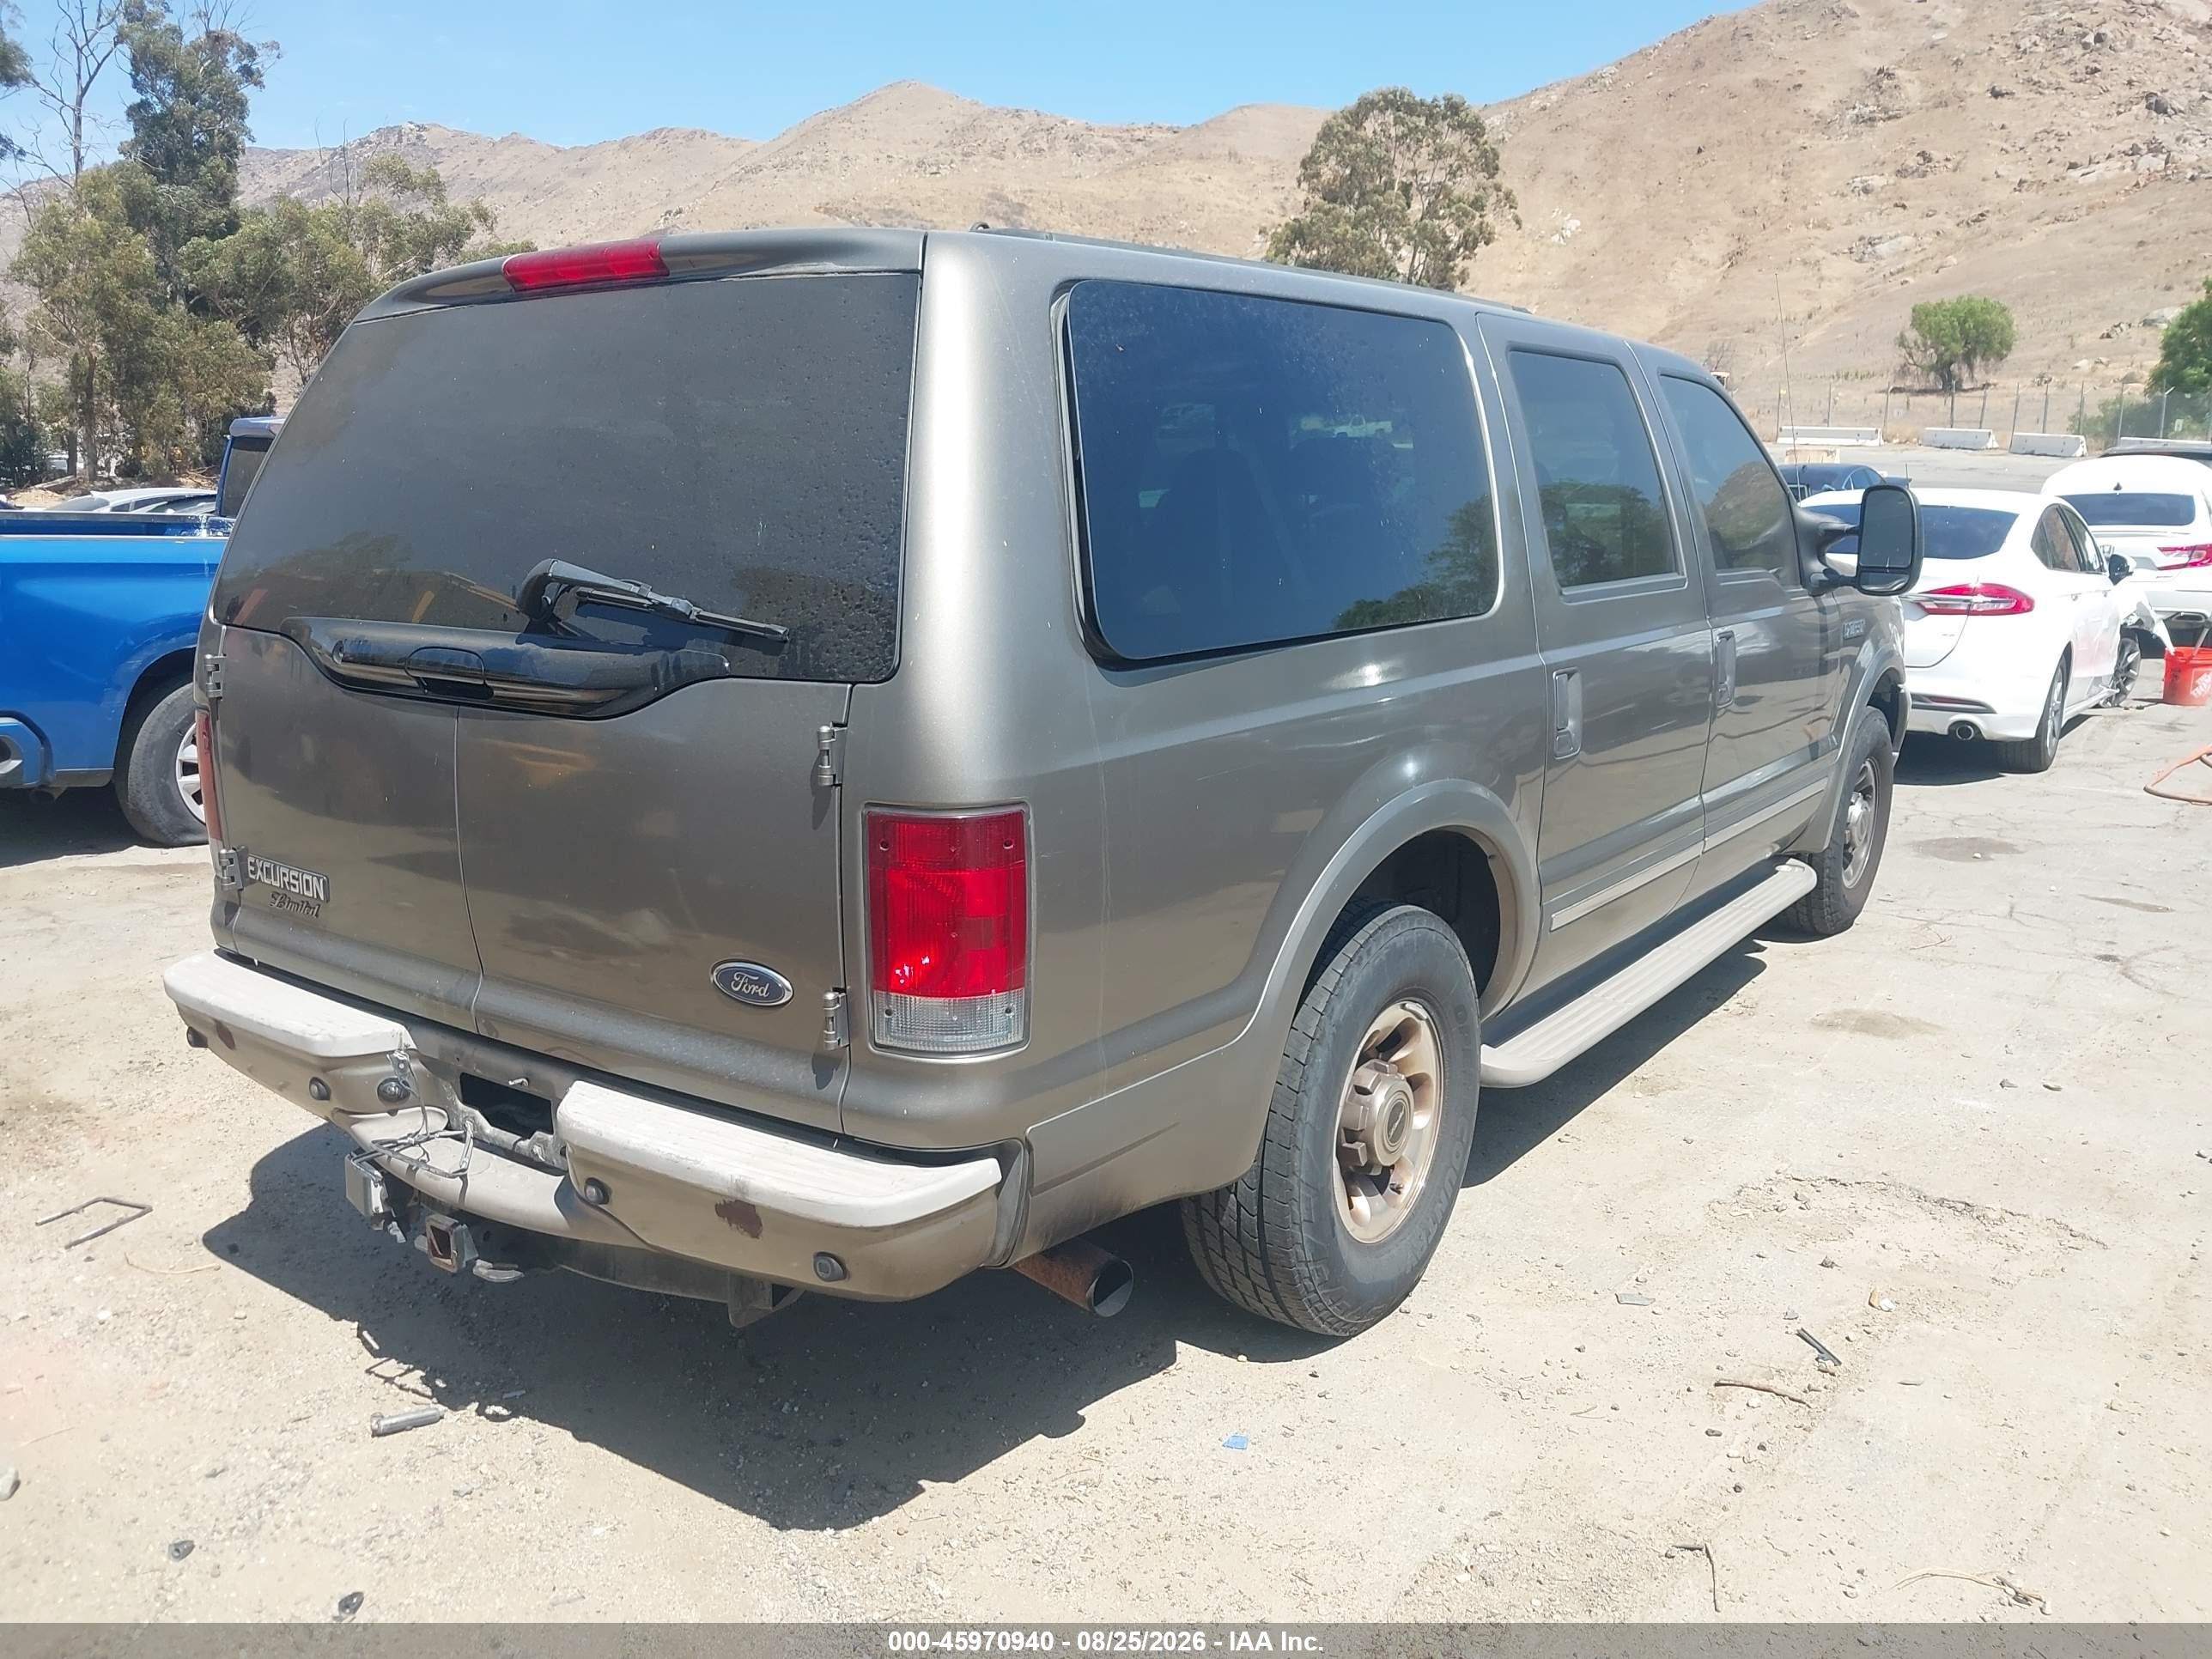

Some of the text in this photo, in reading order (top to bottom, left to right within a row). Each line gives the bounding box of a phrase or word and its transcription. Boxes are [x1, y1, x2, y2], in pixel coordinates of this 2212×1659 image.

[247, 856, 325, 902] EXCURSION
[269, 891, 322, 919] Limited
[731, 971, 770, 998] Ford
